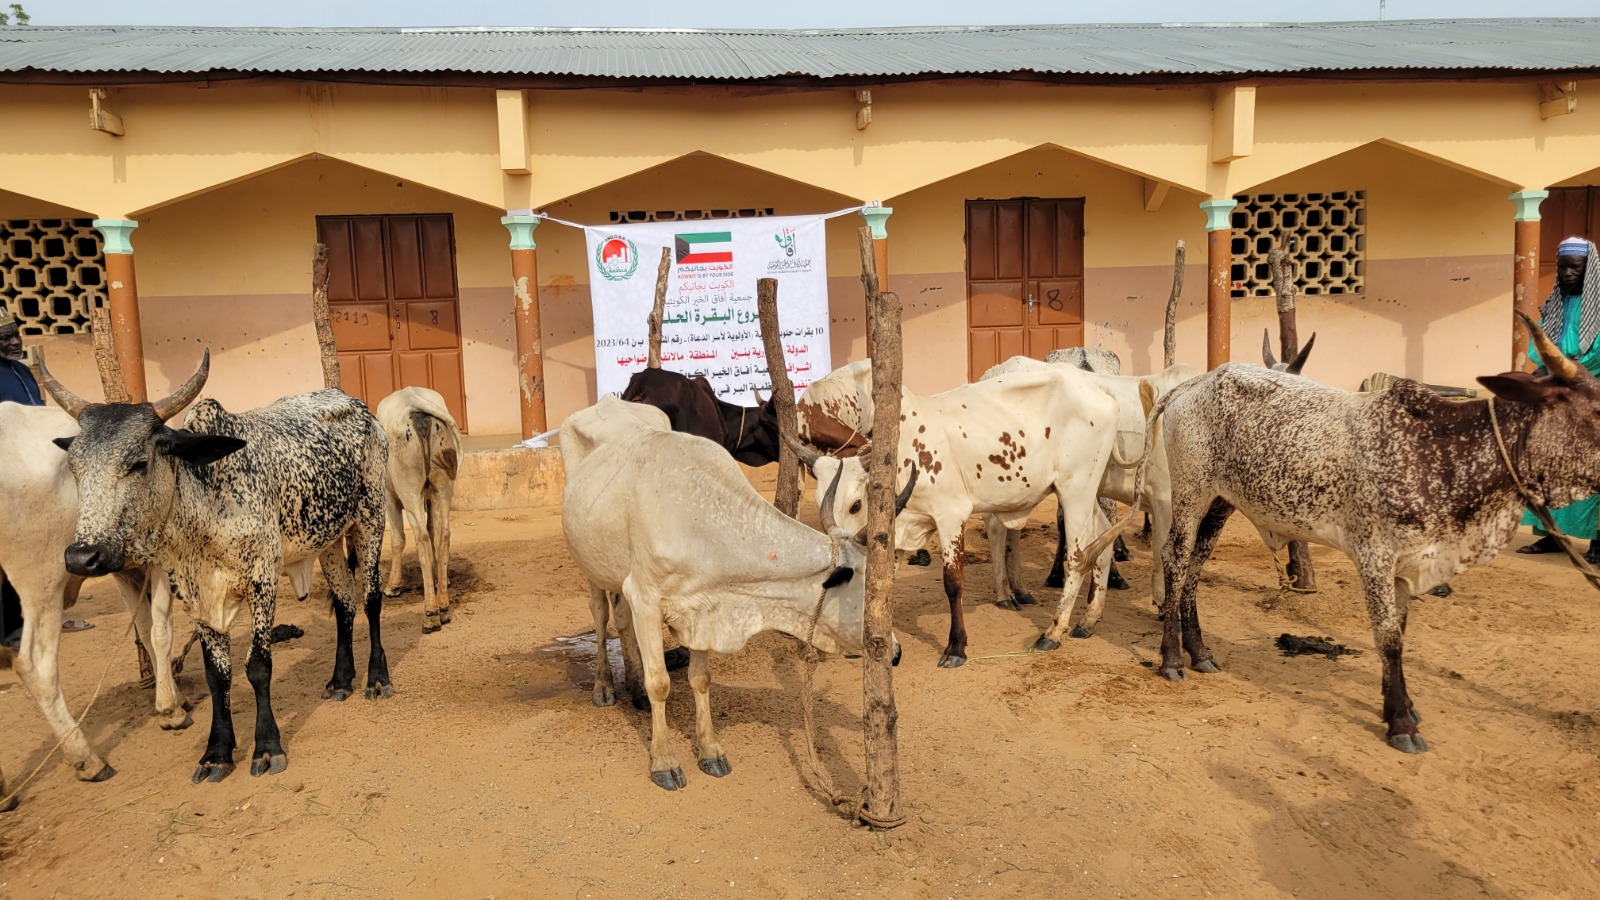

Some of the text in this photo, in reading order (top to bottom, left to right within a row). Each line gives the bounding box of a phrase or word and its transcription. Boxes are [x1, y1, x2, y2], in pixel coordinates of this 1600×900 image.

[678, 264, 733, 274] الكويت بجانبكم
[678, 280, 734, 295] الكويت بجانبكم
[666, 296, 690, 308] الكويتي
[693, 294, 709, 306] الخير
[730, 293, 752, 304] جمعية
[1047, 289, 1064, 312] 8
[694, 308, 734, 326] البقرة
[795, 328, 814, 338] بقرات
[815, 327, 824, 335] 10
[671, 334, 682, 344] رقم
[731, 347, 750, 359] بنين
[711, 366, 732, 378] الخير
[718, 384, 730, 397] في
[733, 383, 748, 395] البر
